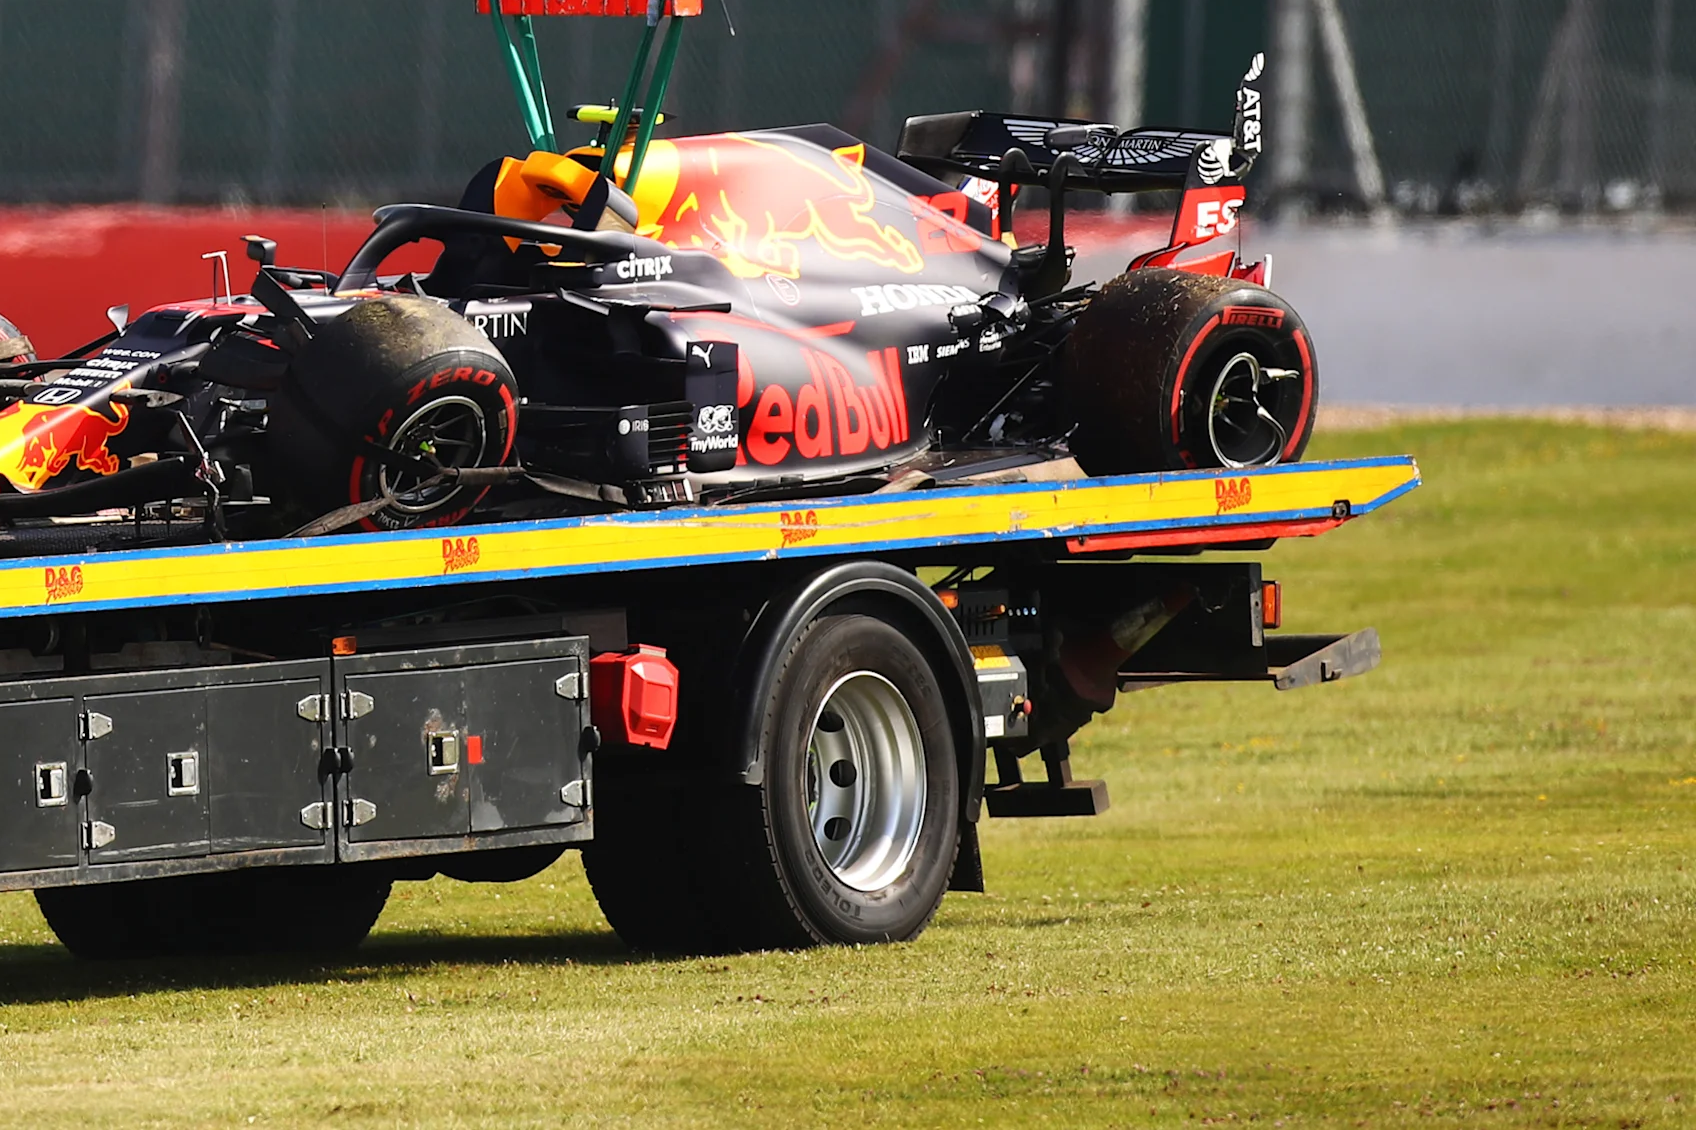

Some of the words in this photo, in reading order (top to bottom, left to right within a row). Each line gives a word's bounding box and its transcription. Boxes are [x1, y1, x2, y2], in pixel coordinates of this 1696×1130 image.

[1241, 86, 1263, 154] AT&T
[1117, 138, 1162, 151] MARTIN
[850, 283, 982, 317] HONDA
[471, 310, 529, 340] RTIN
[1221, 305, 1286, 330] PIRELLI
[906, 343, 930, 365] IBM
[405, 366, 497, 407] ZERO
[690, 433, 739, 453] myWorld
[442, 536, 479, 559] D&G
[45, 565, 83, 588] D&G
